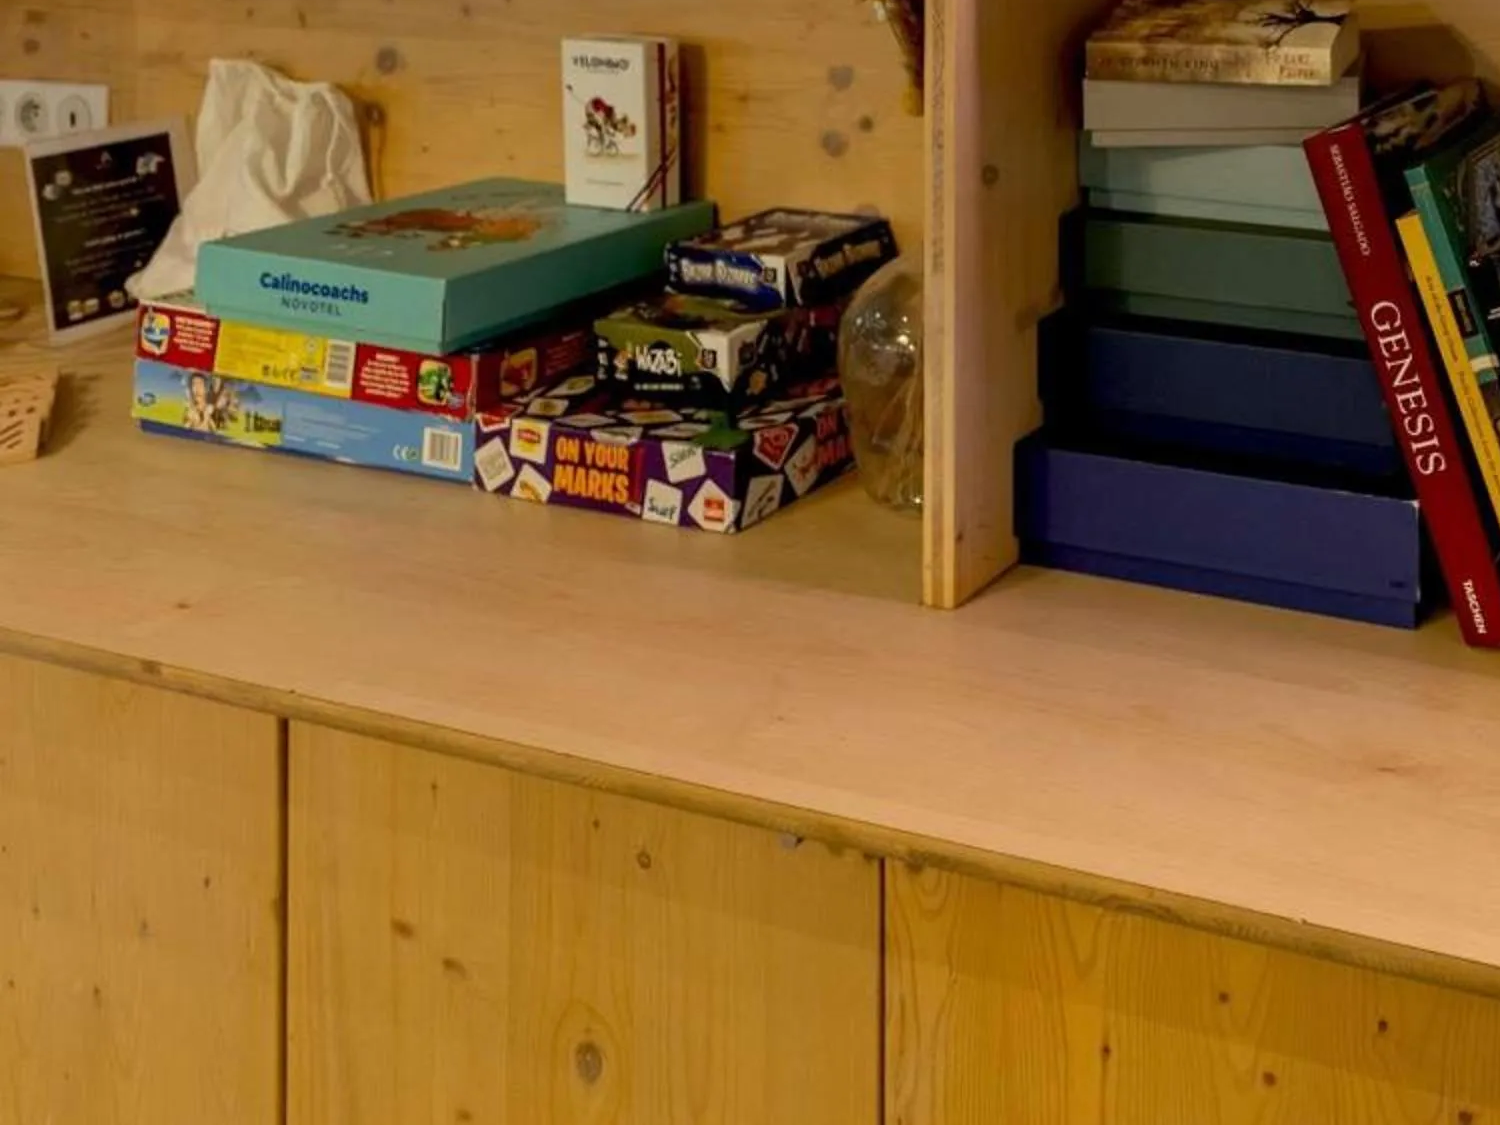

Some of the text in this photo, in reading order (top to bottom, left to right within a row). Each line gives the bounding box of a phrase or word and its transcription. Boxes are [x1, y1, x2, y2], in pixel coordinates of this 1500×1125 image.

[260, 272, 369, 304] Calinocoachs
[281, 296, 342, 316] NOVOTEL
[1371, 301, 1447, 476] GENESIS
[556, 436, 629, 473] ON YOUR
[554, 464, 629, 504] MARKS
[1462, 578, 1488, 635] TASCHEN
